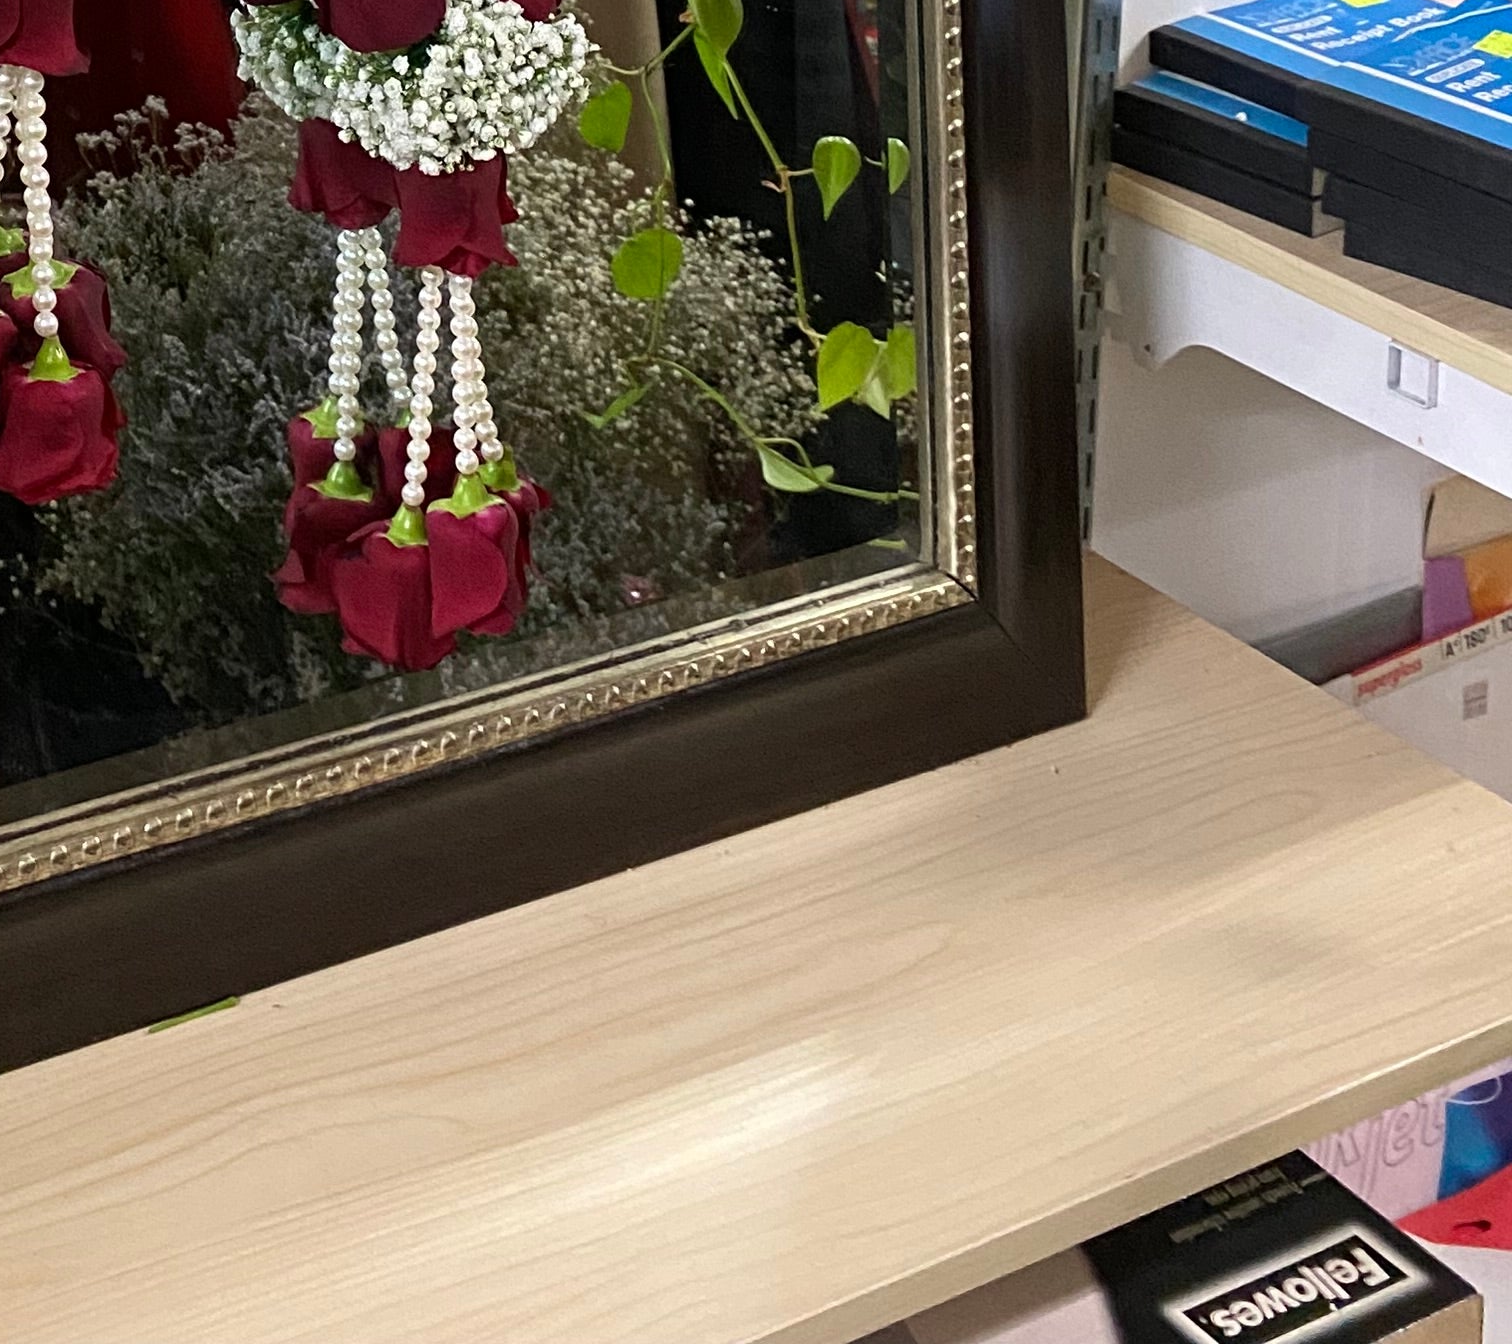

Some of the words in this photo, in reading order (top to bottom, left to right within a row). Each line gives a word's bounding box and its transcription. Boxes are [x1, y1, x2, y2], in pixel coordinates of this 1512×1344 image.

[1288, 26, 1343, 42] Rent
[1310, 23, 1393, 51] Receipt
[1388, 7, 1446, 27] Book
[1445, 71, 1502, 93] Rent
